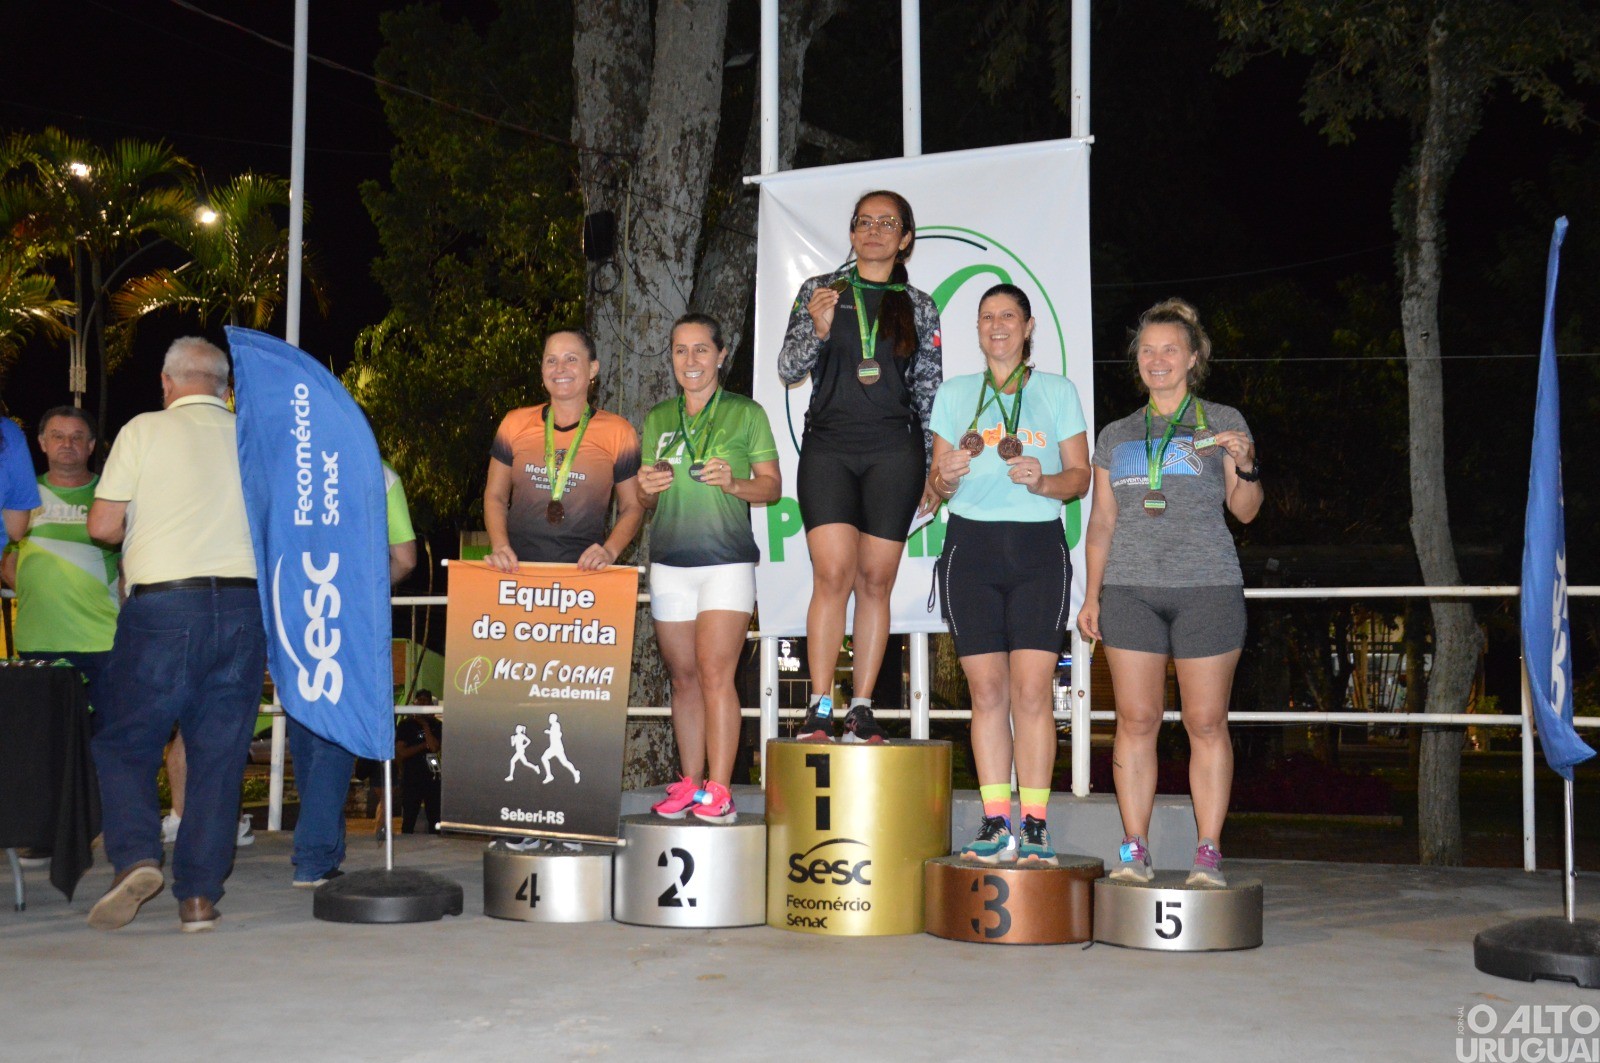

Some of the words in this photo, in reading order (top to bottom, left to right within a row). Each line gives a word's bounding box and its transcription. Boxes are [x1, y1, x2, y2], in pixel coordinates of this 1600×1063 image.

[290, 382, 314, 526] Fecomércio
[321, 450, 340, 527] Senac
[498, 580, 596, 614] Equipe
[298, 551, 345, 706] Sesc
[472, 614, 507, 641] de
[514, 617, 617, 646] corrida
[541, 659, 615, 685] FORMA
[528, 684, 611, 701] Academia
[805, 753, 831, 831] 1
[500, 806, 565, 826] Seberi-RS
[657, 847, 698, 908] 2
[787, 852, 872, 886] Sesc
[515, 872, 541, 909] 4
[786, 894, 872, 912] Fecomércio
[970, 874, 1012, 939] 3
[786, 912, 828, 929] Senac
[1154, 900, 1183, 940] 5
